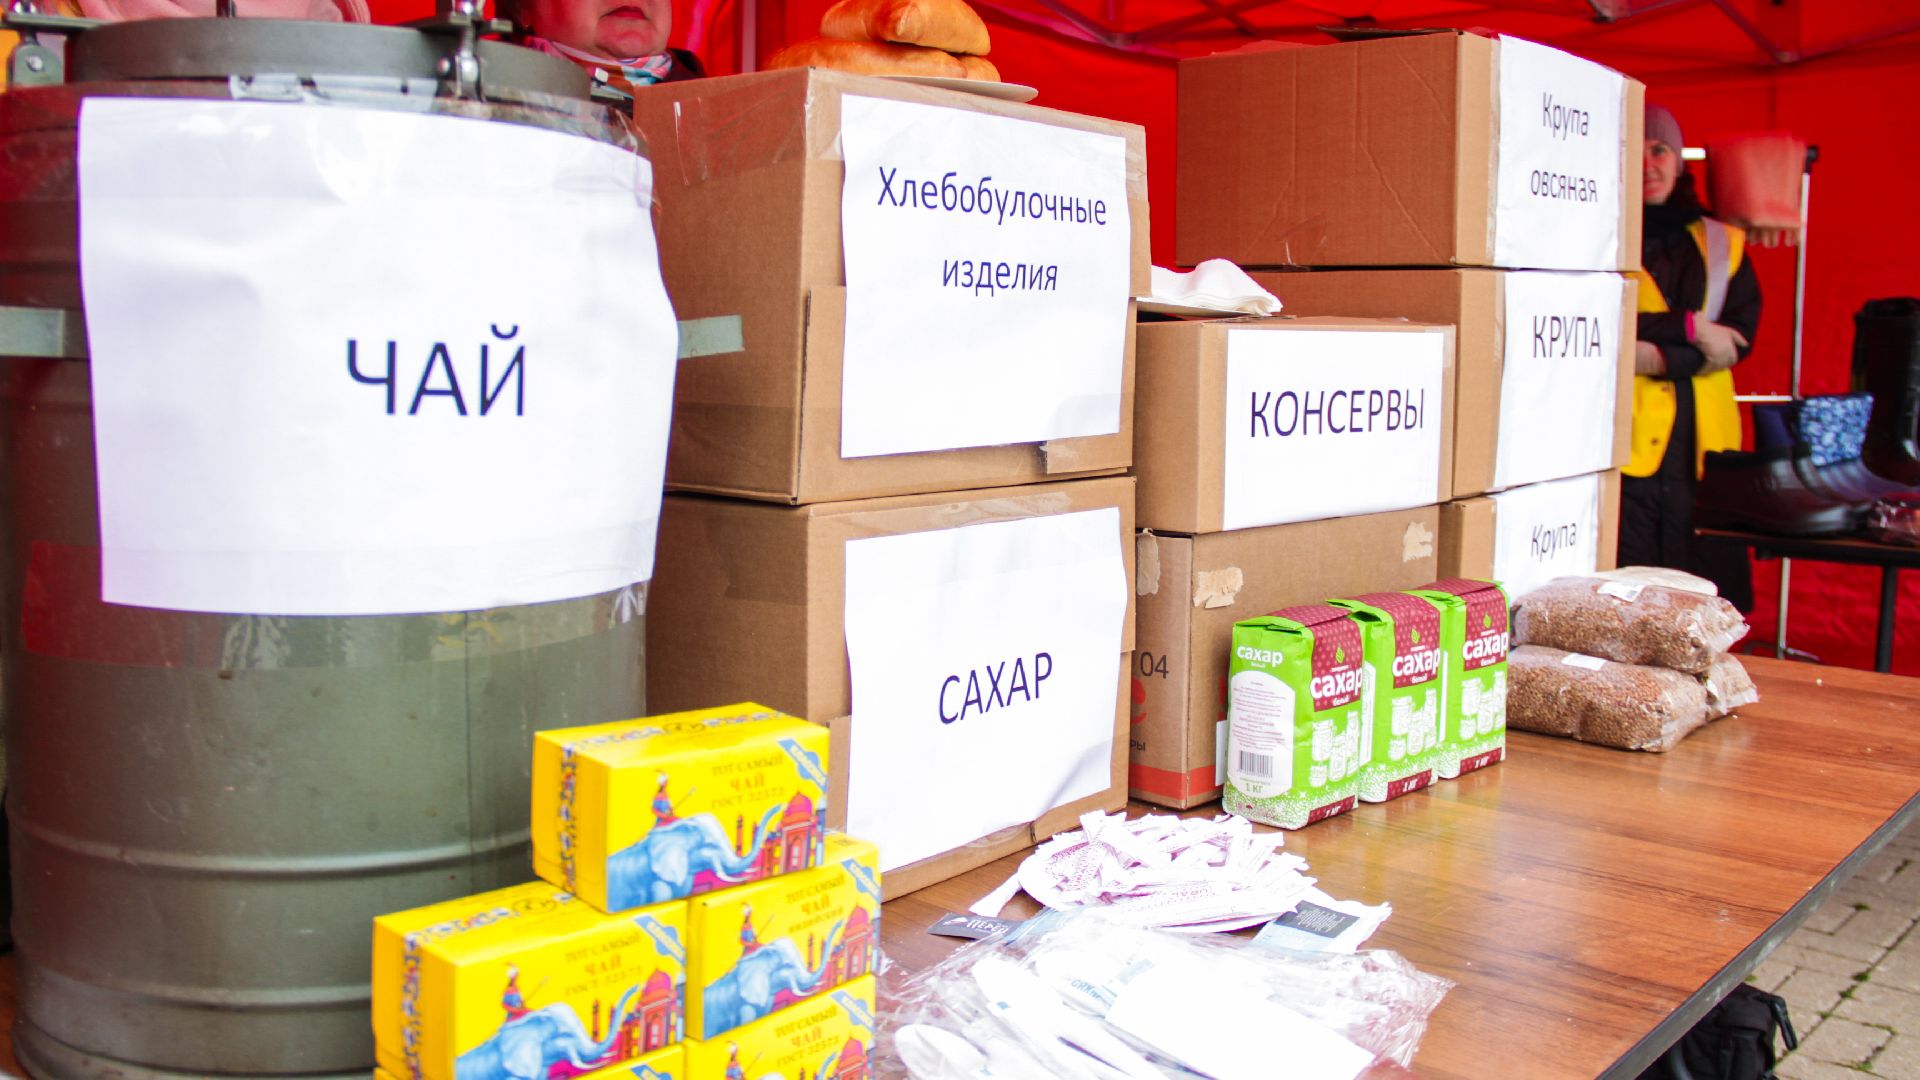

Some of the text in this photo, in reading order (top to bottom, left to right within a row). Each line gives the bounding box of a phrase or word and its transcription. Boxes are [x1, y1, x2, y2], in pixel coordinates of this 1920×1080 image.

[1542, 92, 1590, 138] Крупа
[878, 166, 1107, 226] Хлебобулочные
[1530, 168, 1598, 203] овсяная
[942, 259, 1058, 297] изделия
[1533, 315, 1602, 359] КРУПА
[347, 323, 527, 416] ЧАЙ
[1250, 388, 1425, 438] КОНСЕРВЫ
[1531, 522, 1577, 562] Крупа
[1237, 645, 1283, 668] сахар
[1392, 647, 1440, 677] сахар
[1462, 631, 1508, 661] сахар
[938, 652, 1053, 725] САХАР
[1310, 667, 1363, 699] сахар
[730, 771, 766, 792] ЧАЙ
[801, 893, 831, 915] ЧАЙ
[791, 1026, 822, 1048] ЧАЙ
